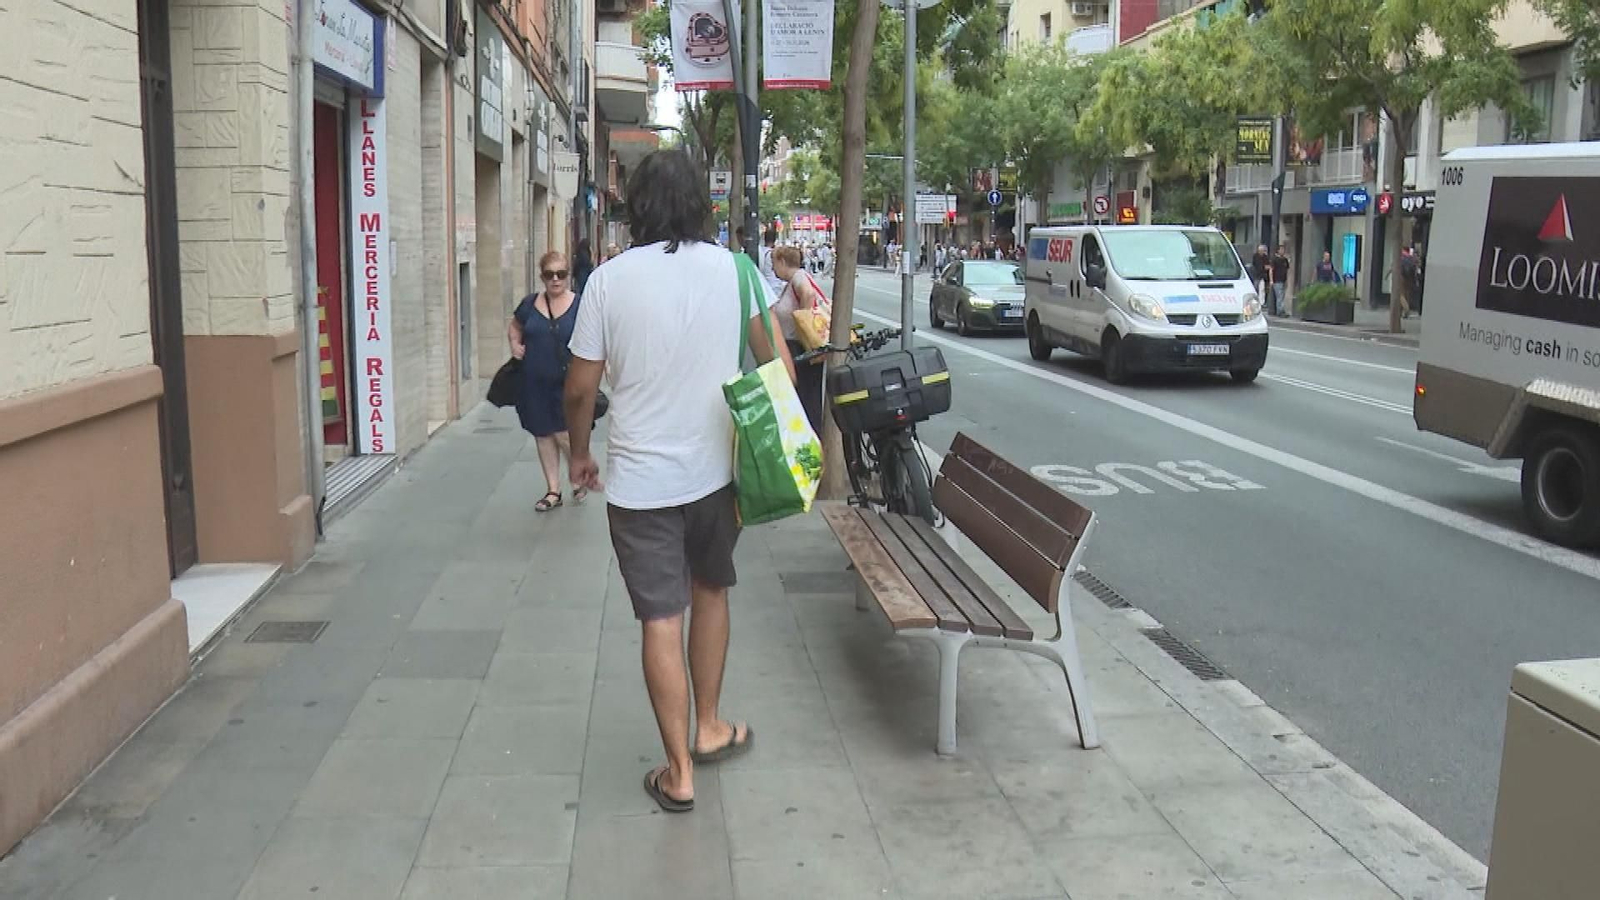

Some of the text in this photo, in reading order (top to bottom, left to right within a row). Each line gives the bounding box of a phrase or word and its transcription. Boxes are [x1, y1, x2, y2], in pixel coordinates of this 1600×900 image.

[360, 98, 376, 198] LLANES
[1441, 166, 1464, 186] 1006
[1048, 238, 1074, 264] SEUR
[1491, 246, 1600, 299] LOOMI
[359, 212, 382, 342] MERCERIA
[1459, 321, 1522, 357] Managing
[1526, 338, 1562, 360] cash
[1566, 341, 1579, 364] in
[365, 357, 385, 454] REGALS
[1030, 459, 1266, 497] BUS
